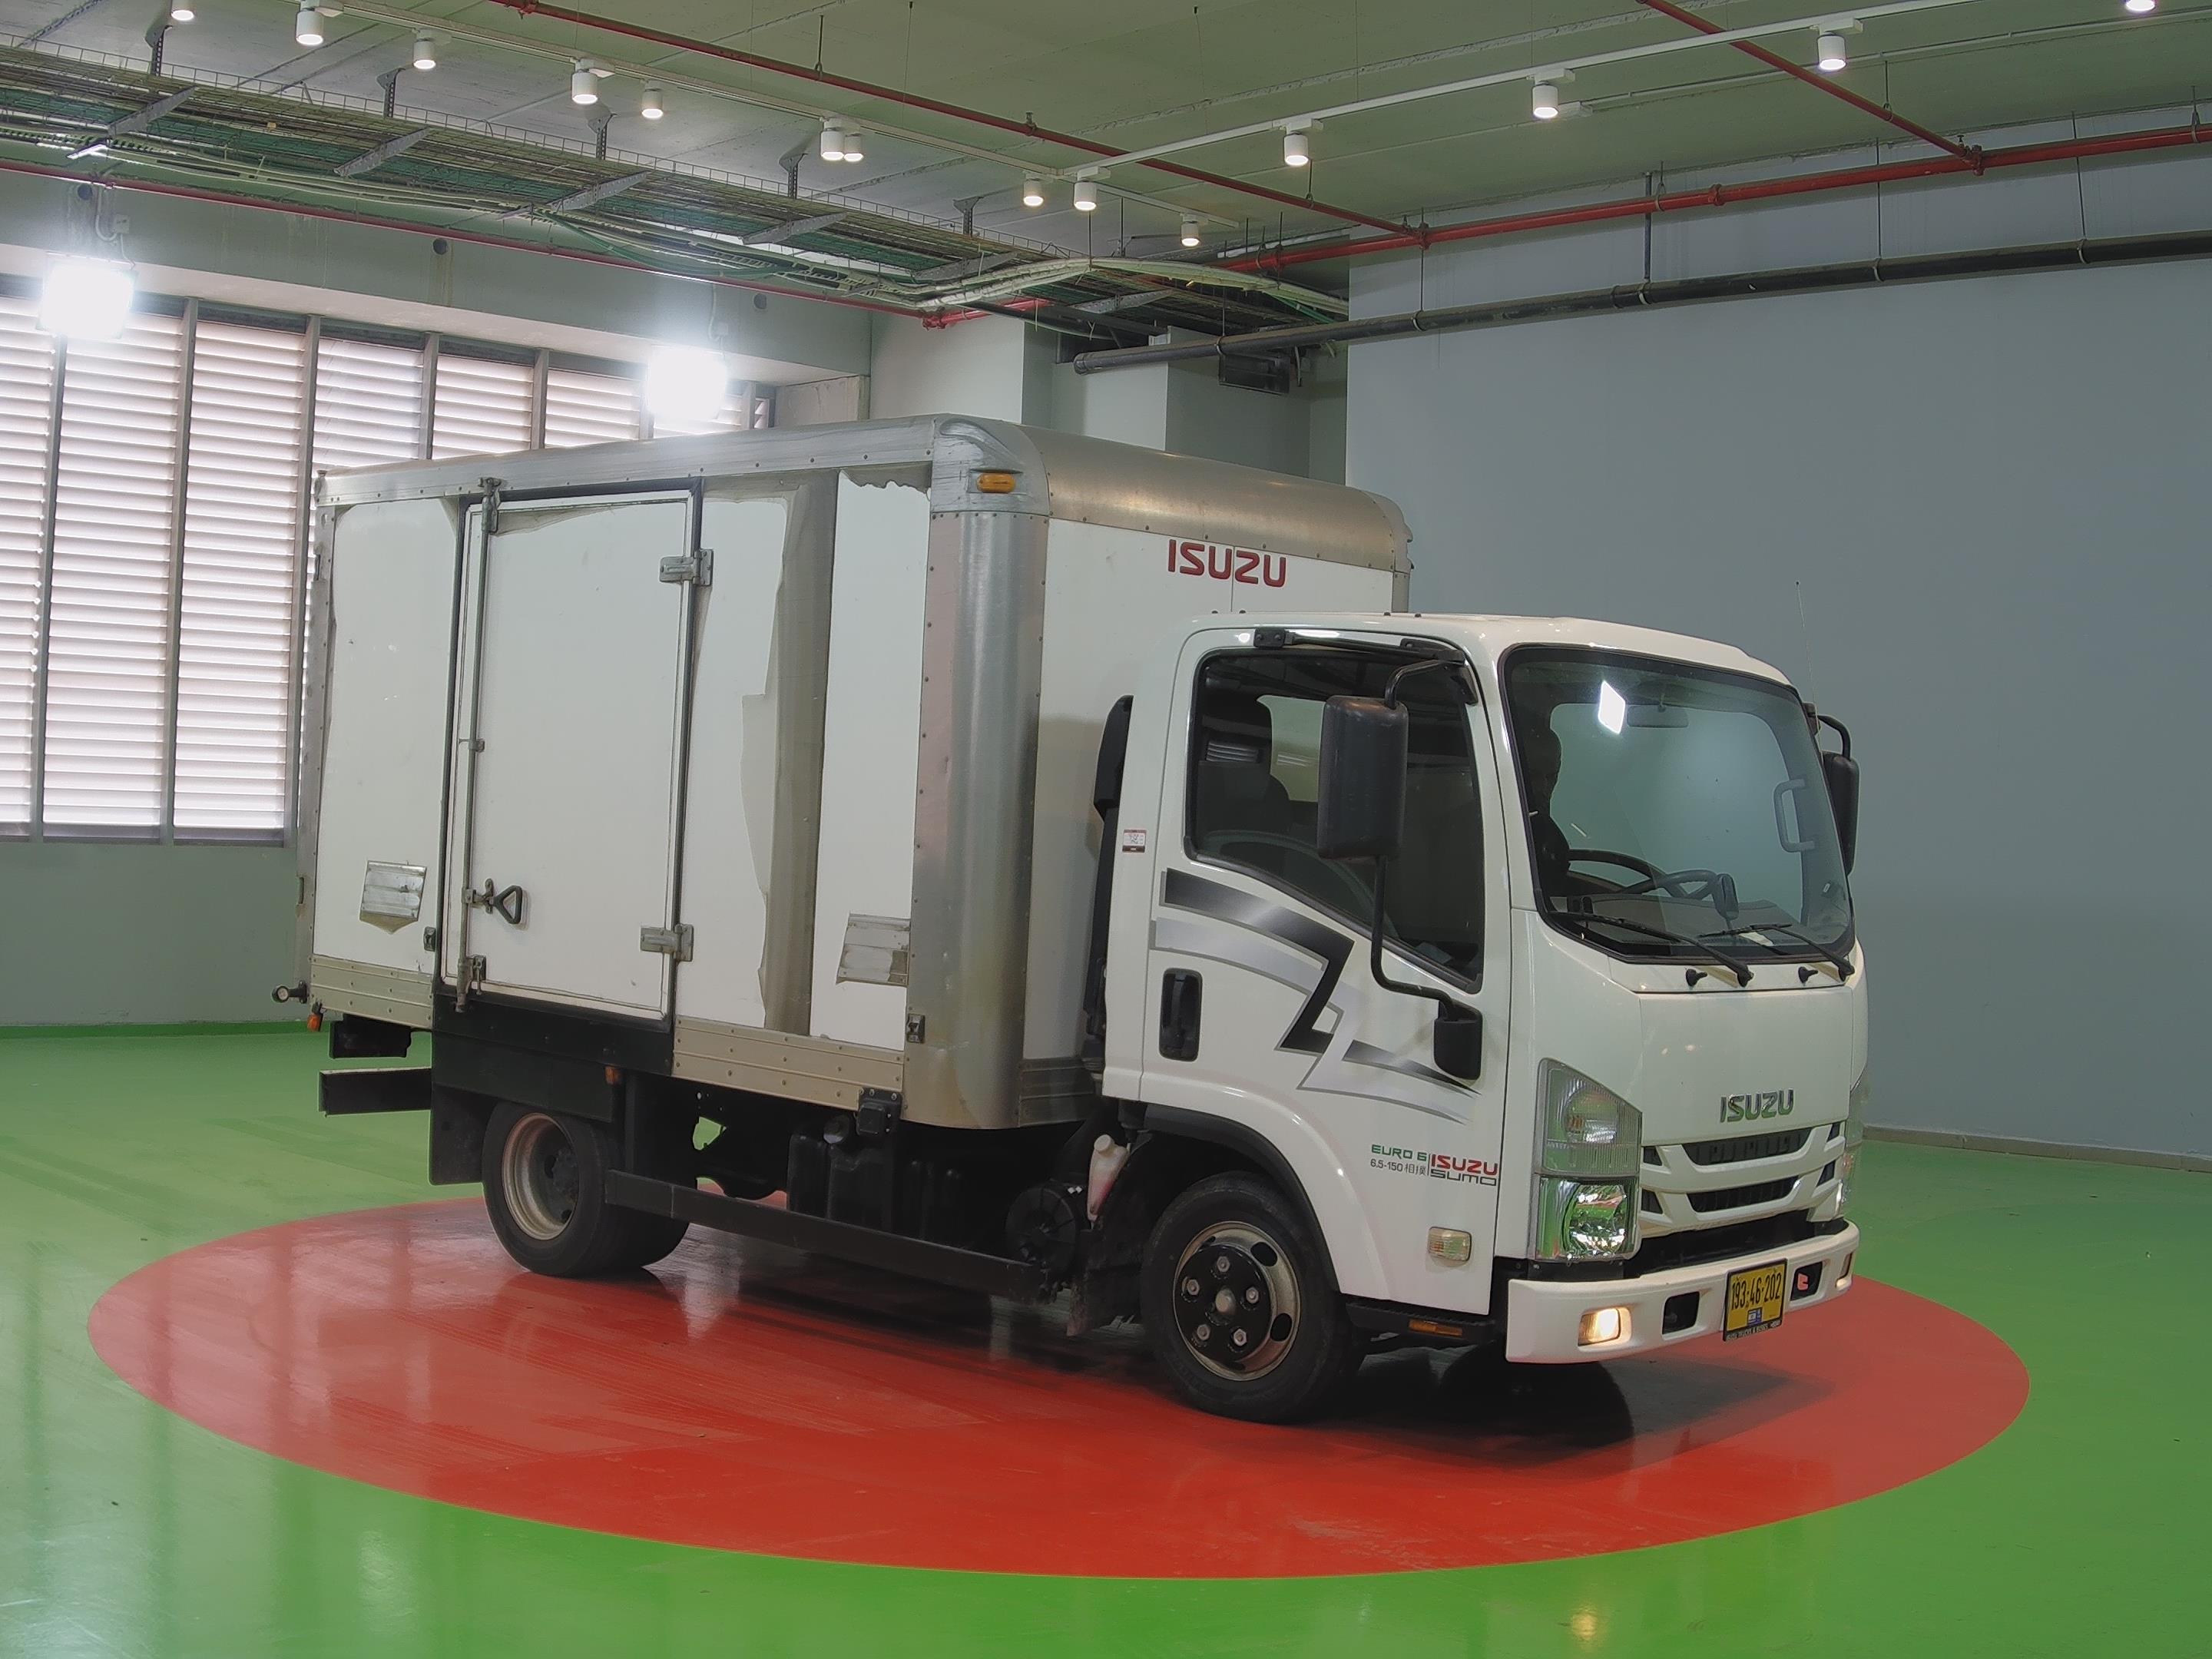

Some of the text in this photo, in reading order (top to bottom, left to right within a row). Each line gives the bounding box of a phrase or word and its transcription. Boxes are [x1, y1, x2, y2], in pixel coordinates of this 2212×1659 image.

[1168, 539, 1286, 588] ISUZU
[1720, 1088, 1794, 1123] ISUZU
[1371, 1144, 1427, 1162] EURO 6
[1370, 1158, 1403, 1172] 6.5-150
[1431, 1154, 1498, 1176] ISUZU
[1430, 1169, 1497, 1187] SUMO
